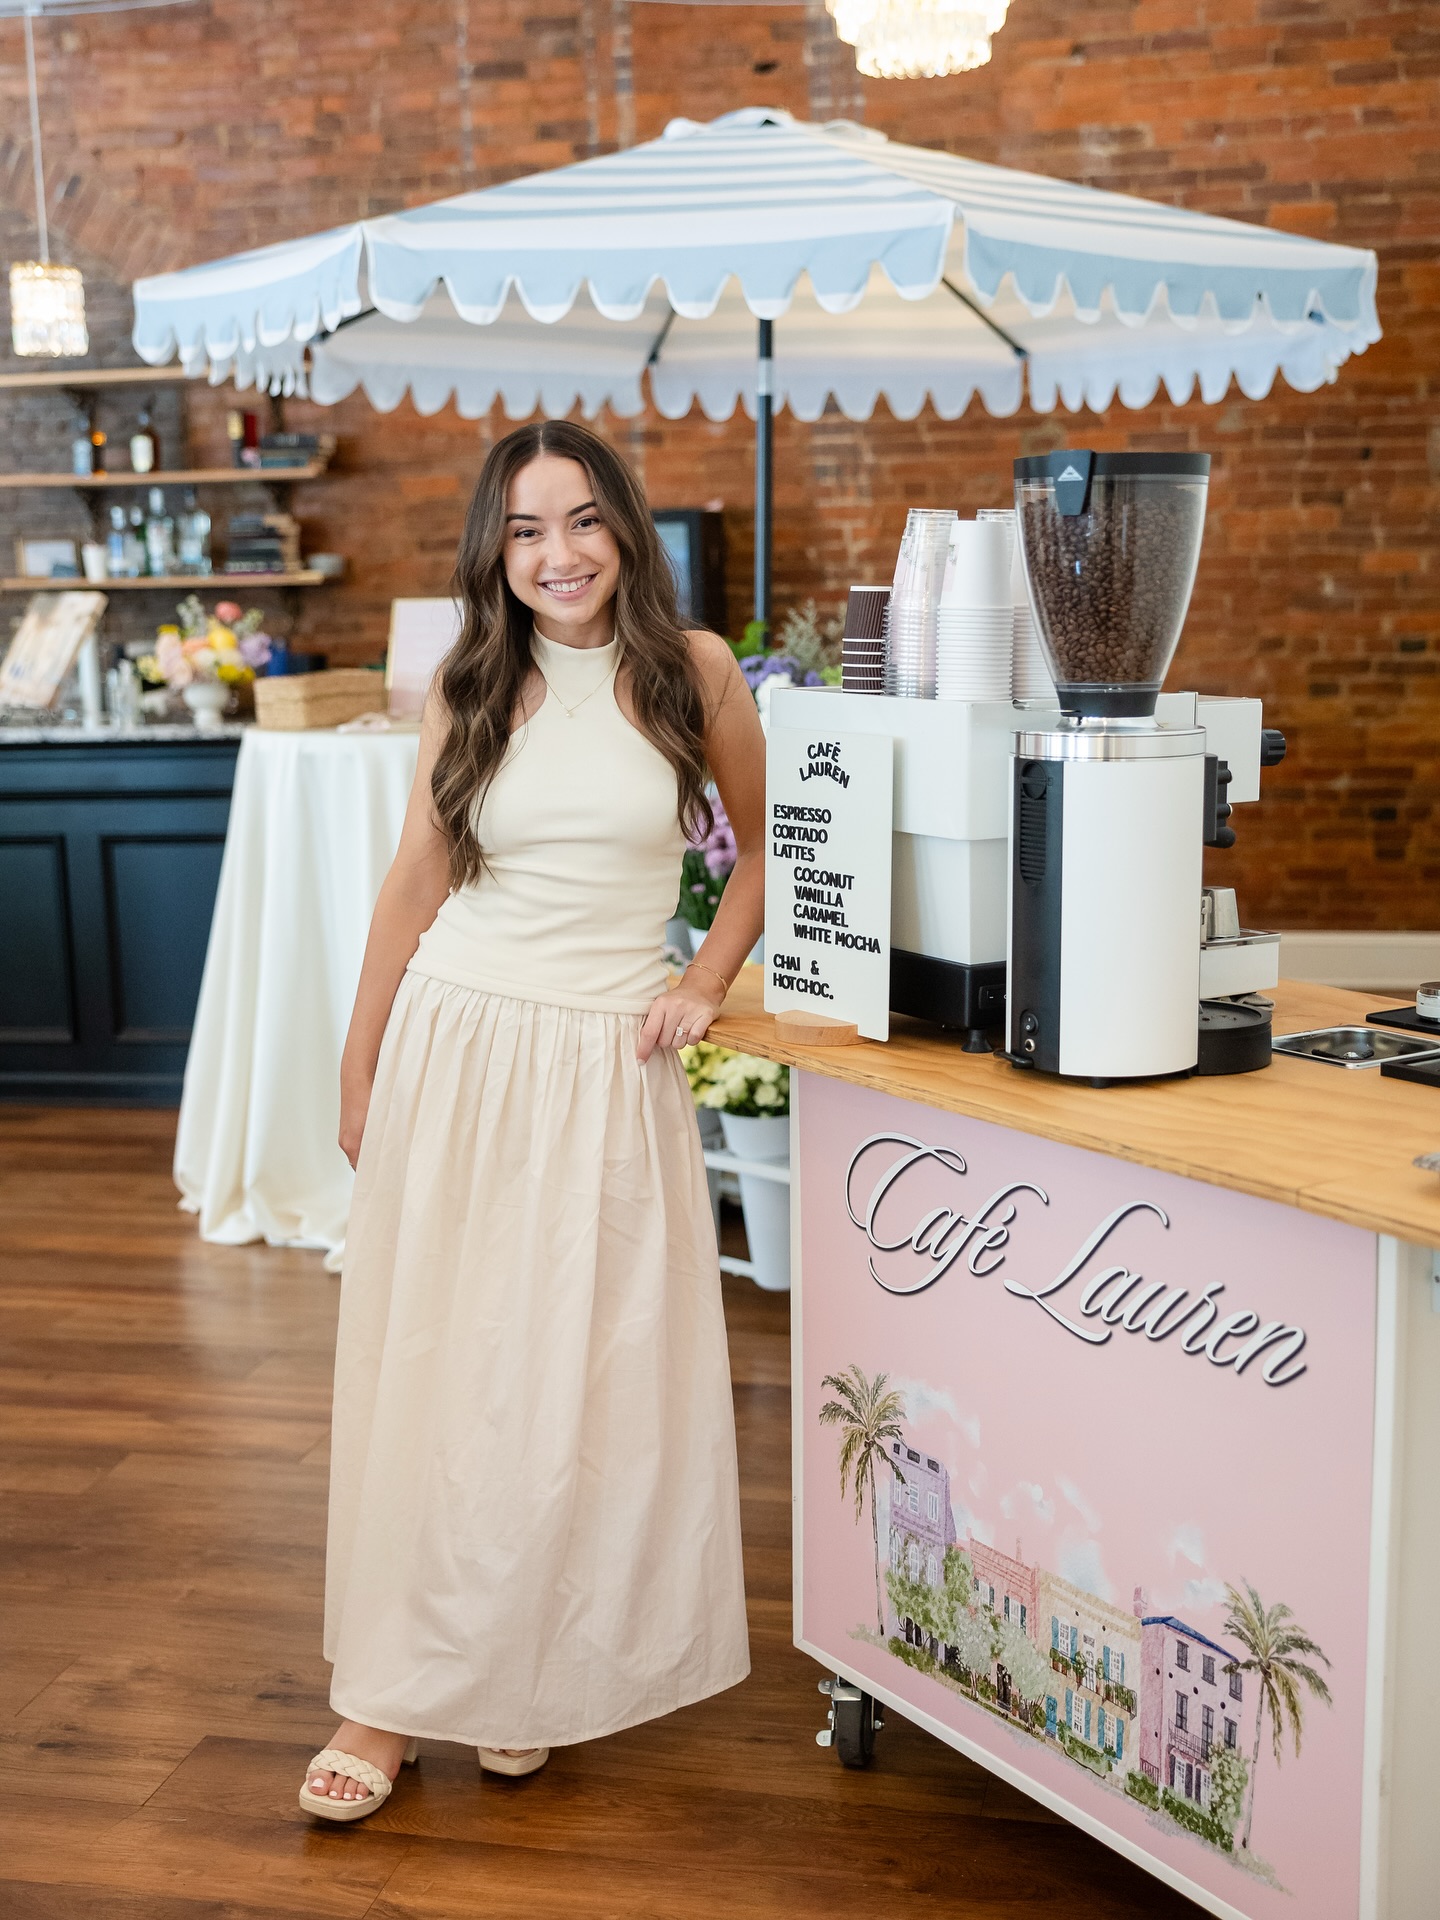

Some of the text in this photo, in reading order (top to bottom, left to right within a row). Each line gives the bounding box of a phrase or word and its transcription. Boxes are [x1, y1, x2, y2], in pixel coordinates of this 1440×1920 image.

[799, 761, 850, 788] LAUREN
[774, 804, 831, 824] ESPRESSO
[773, 824, 828, 844] CORTADO
[774, 843, 816, 863] LATTES
[794, 867, 855, 891] COCONUT
[794, 886, 844, 908] VANILLA
[793, 904, 849, 927] CARAMEL
[794, 923, 881, 954] WHITE MOCHA
[773, 954, 820, 975] CHAI &
[845, 1132, 1050, 1293] Café
[1003, 1201, 1307, 1387] Lauren
